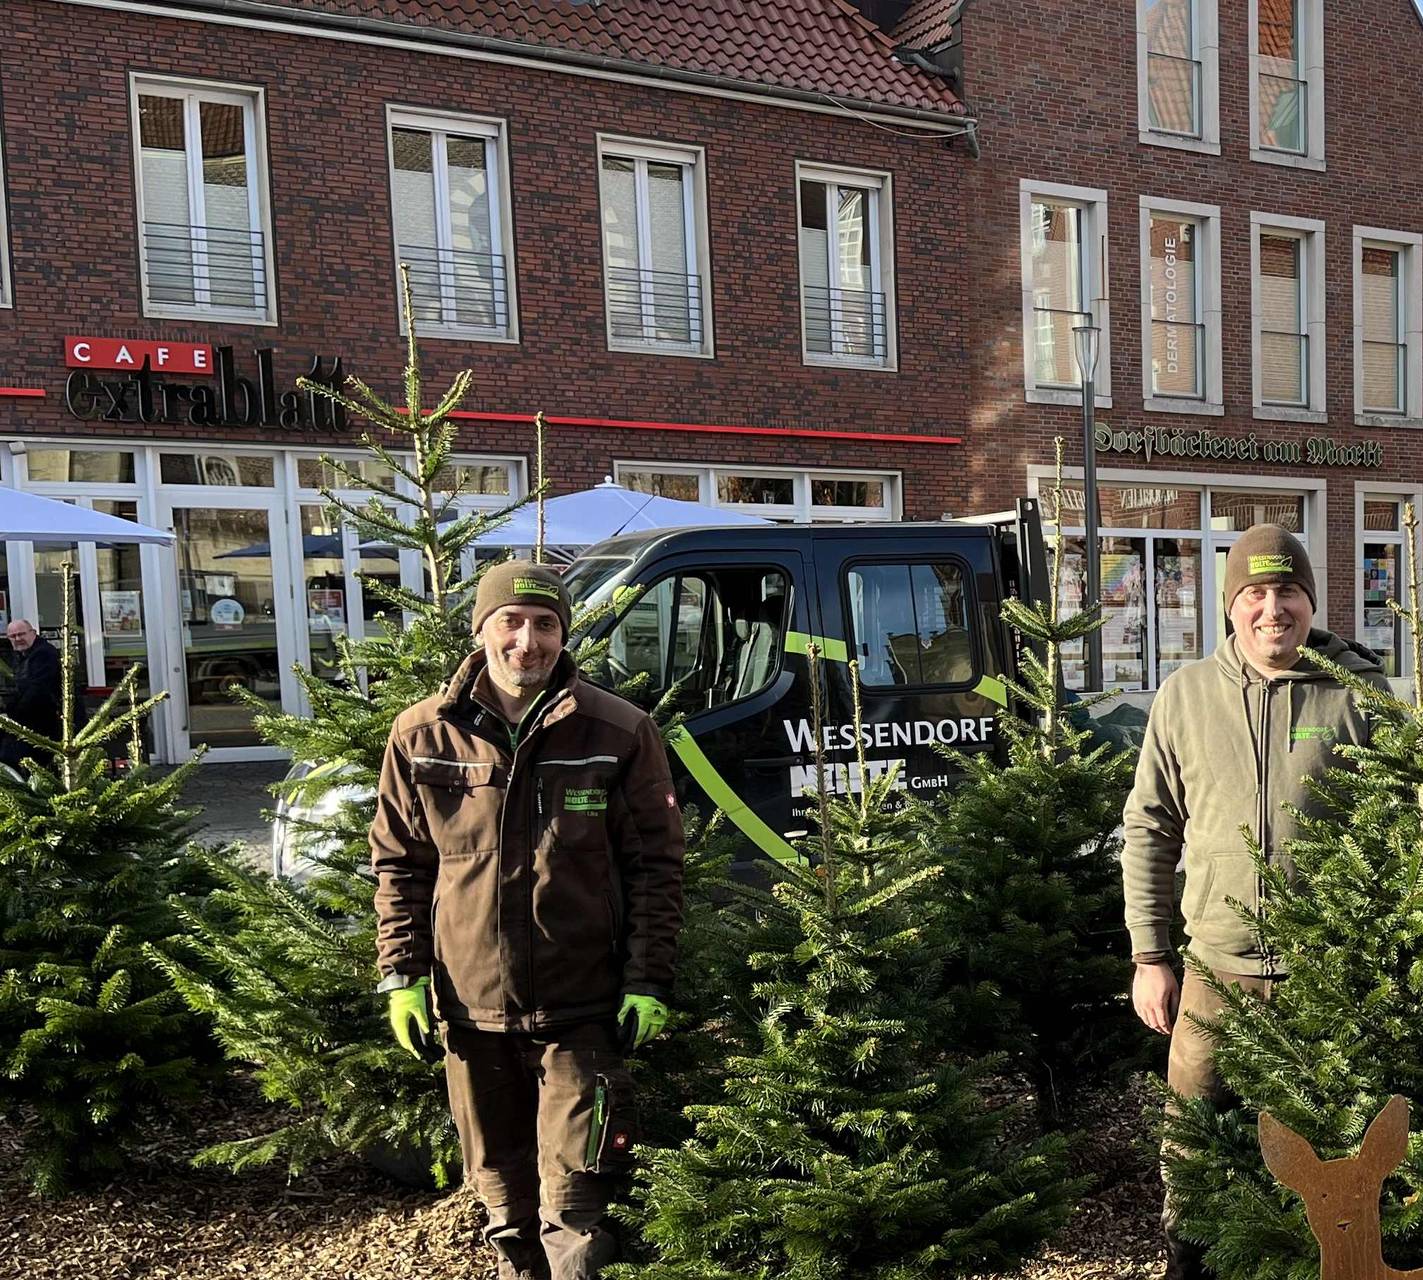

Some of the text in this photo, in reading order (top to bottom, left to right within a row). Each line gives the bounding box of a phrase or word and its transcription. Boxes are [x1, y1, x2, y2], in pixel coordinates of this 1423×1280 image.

[1164, 237, 1178, 373] DERMATOLOGIE
[73, 343, 207, 369] CAFE
[65, 345, 350, 432] extrablatt
[1094, 421, 1385, 468] Dorfbäckerei am Markt
[783, 717, 994, 752] WESSENDORF
